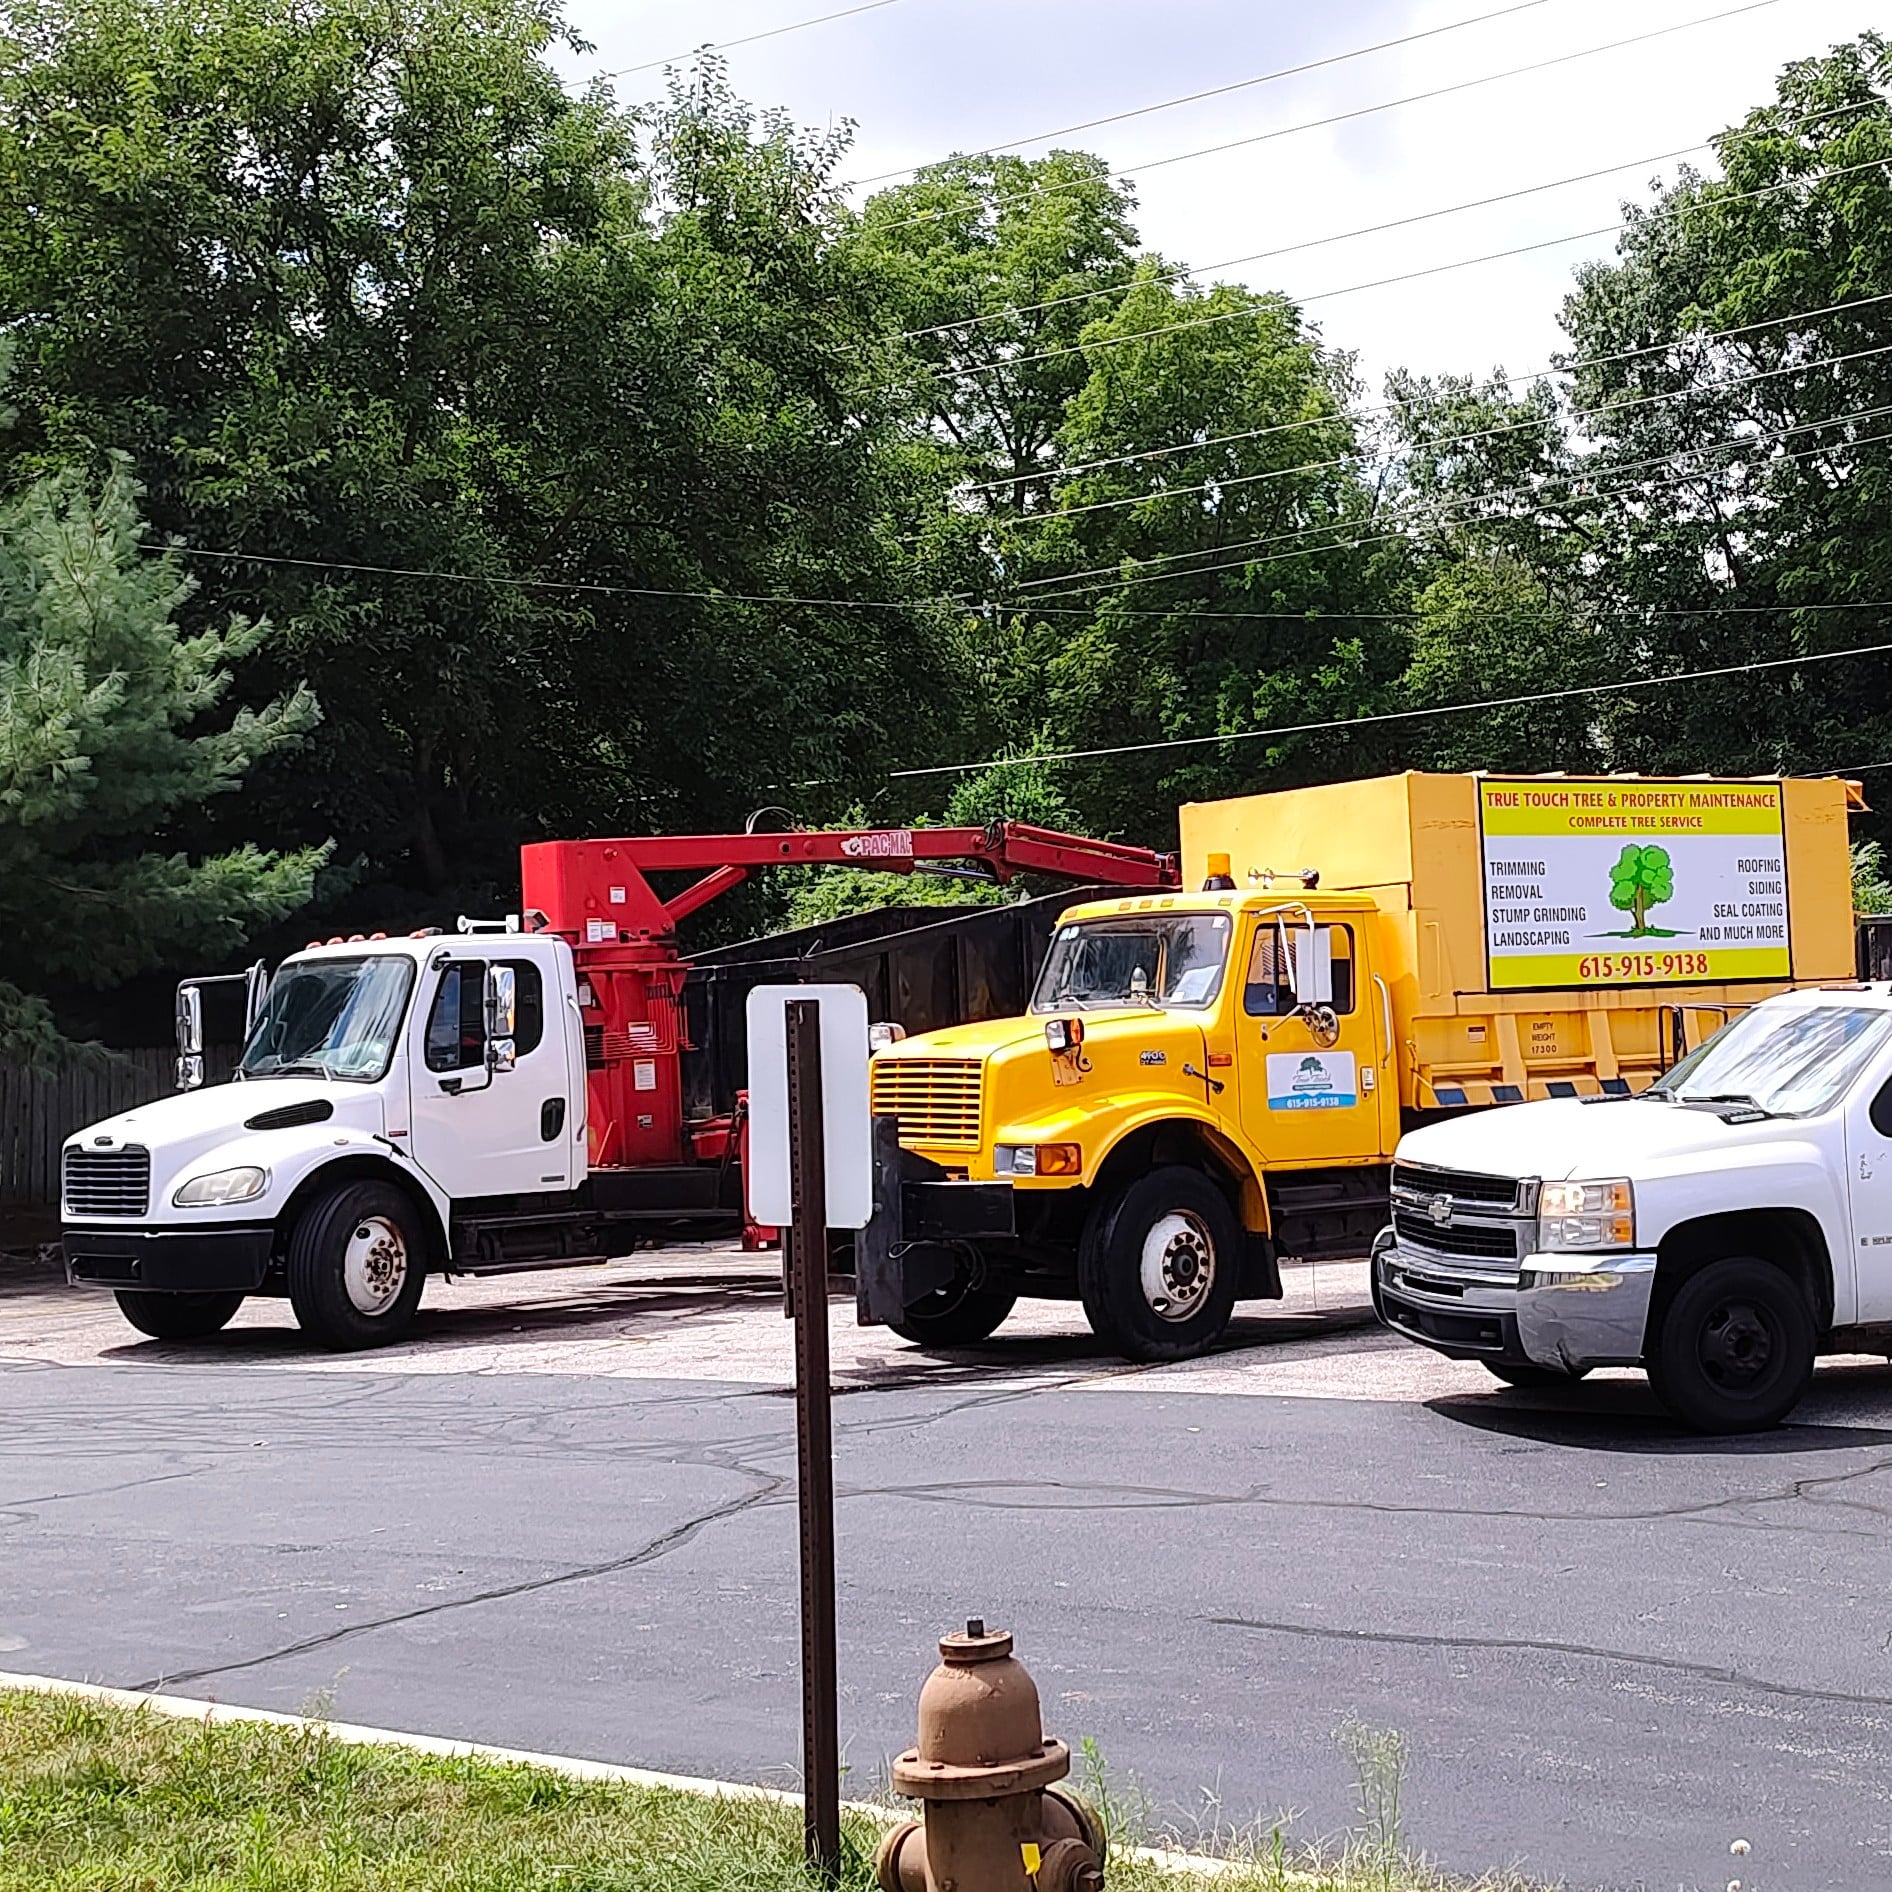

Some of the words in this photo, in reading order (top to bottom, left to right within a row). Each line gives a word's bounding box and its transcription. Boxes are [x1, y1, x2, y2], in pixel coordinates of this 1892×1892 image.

[1486, 792, 1520, 807] TRUE
[1523, 792, 1569, 807] TOUCH
[1573, 793, 1604, 807] TREE
[1607, 793, 1617, 807] &
[1621, 793, 1685, 808] PROPERTY
[1689, 793, 1776, 808] MAINTENANCE
[1568, 816, 1628, 828] COMPLETE
[1630, 816, 1657, 828] TREE
[1659, 816, 1703, 828] SERVICE
[1489, 861, 1546, 876] TRIMMING
[1737, 858, 1781, 873] ROOFING
[1491, 884, 1543, 899] REMOVAL
[1748, 881, 1782, 895] SIDING
[1492, 908, 1530, 923] STUMP
[1533, 907, 1587, 922] GRINDING
[1713, 904, 1740, 918] SEAL
[1741, 903, 1783, 917] COATING
[1493, 930, 1570, 946] LANDSCAPING
[1699, 926, 1721, 941] AND
[1723, 925, 1753, 940] MUCH
[1756, 925, 1785, 939] MORE
[1579, 953, 1708, 978] 615-915-9138
[1532, 1022, 1554, 1031] EMPTY
[1531, 1033, 1556, 1042] WEIGHT
[1531, 1044, 1557, 1055] 17300
[1286, 1097, 1340, 1109] 615-915-9138
